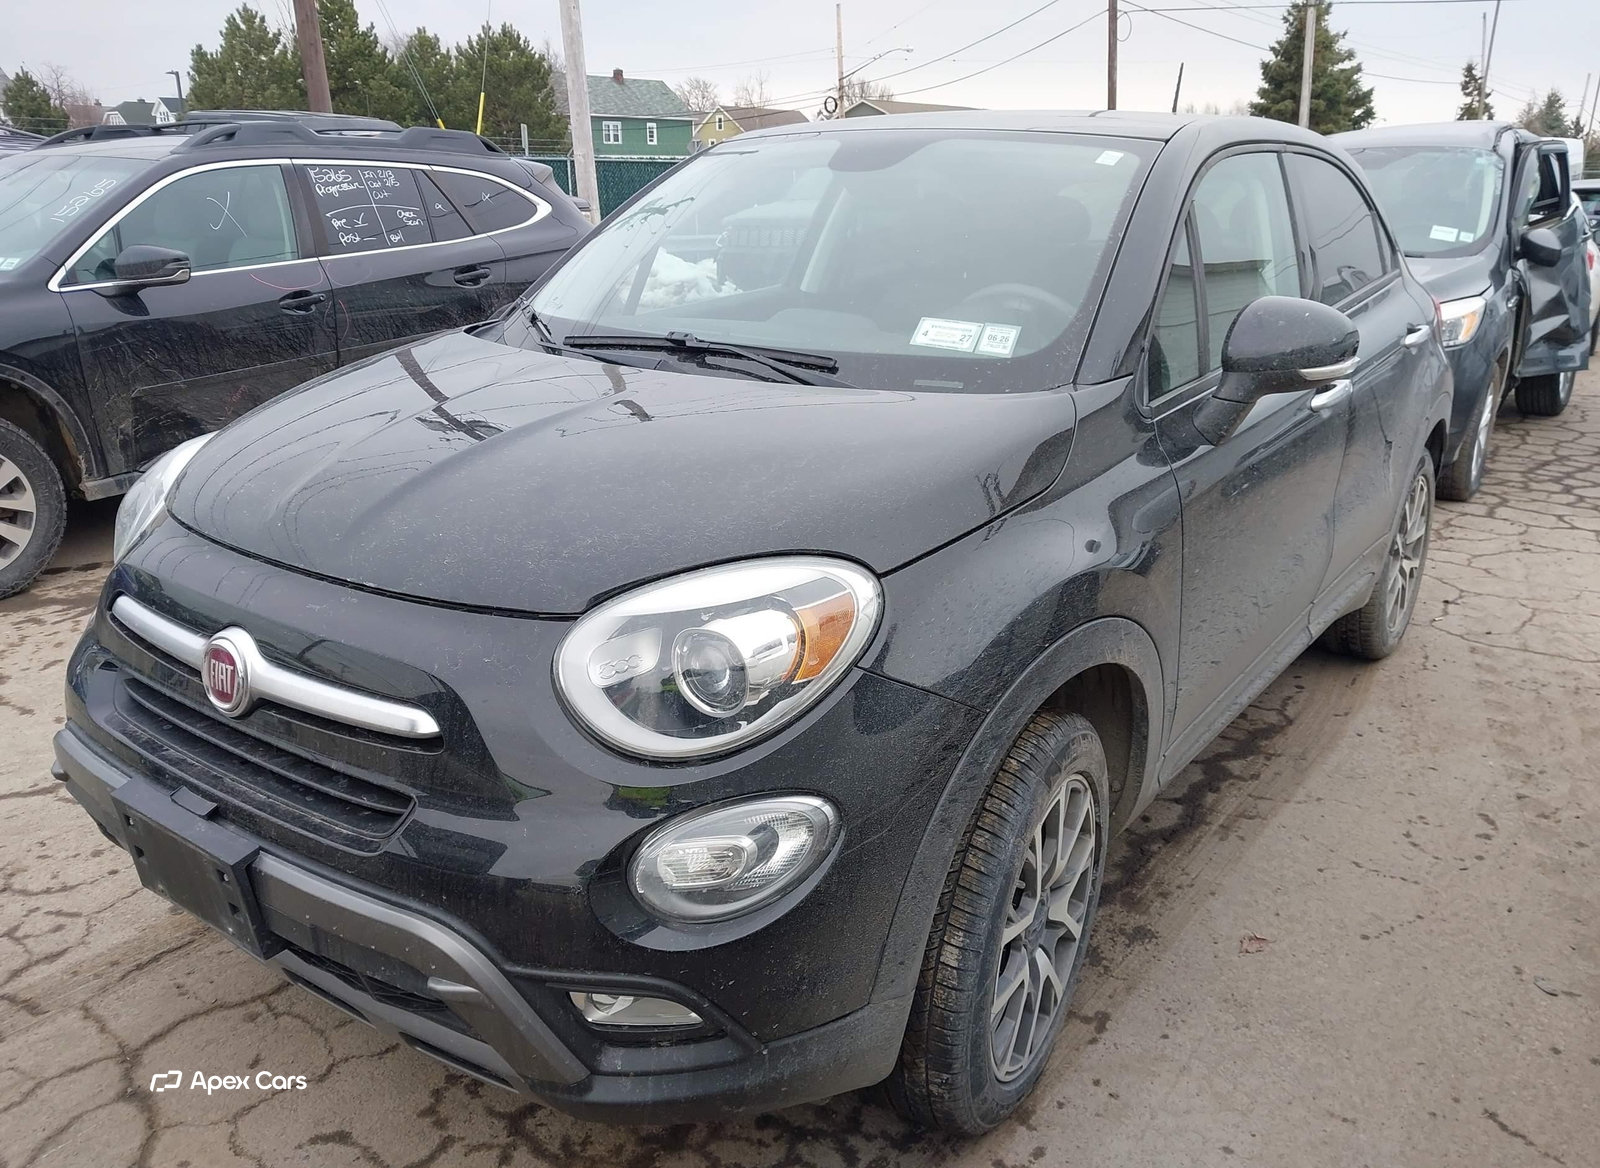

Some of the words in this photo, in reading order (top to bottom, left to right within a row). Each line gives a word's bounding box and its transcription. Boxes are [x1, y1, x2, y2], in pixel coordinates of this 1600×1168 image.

[307, 167, 352, 183] 15265
[50, 178, 117, 223] 15265
[959, 334, 973, 343] 27
[209, 658, 234, 695] FIAT
[598, 654, 643, 680] 500
